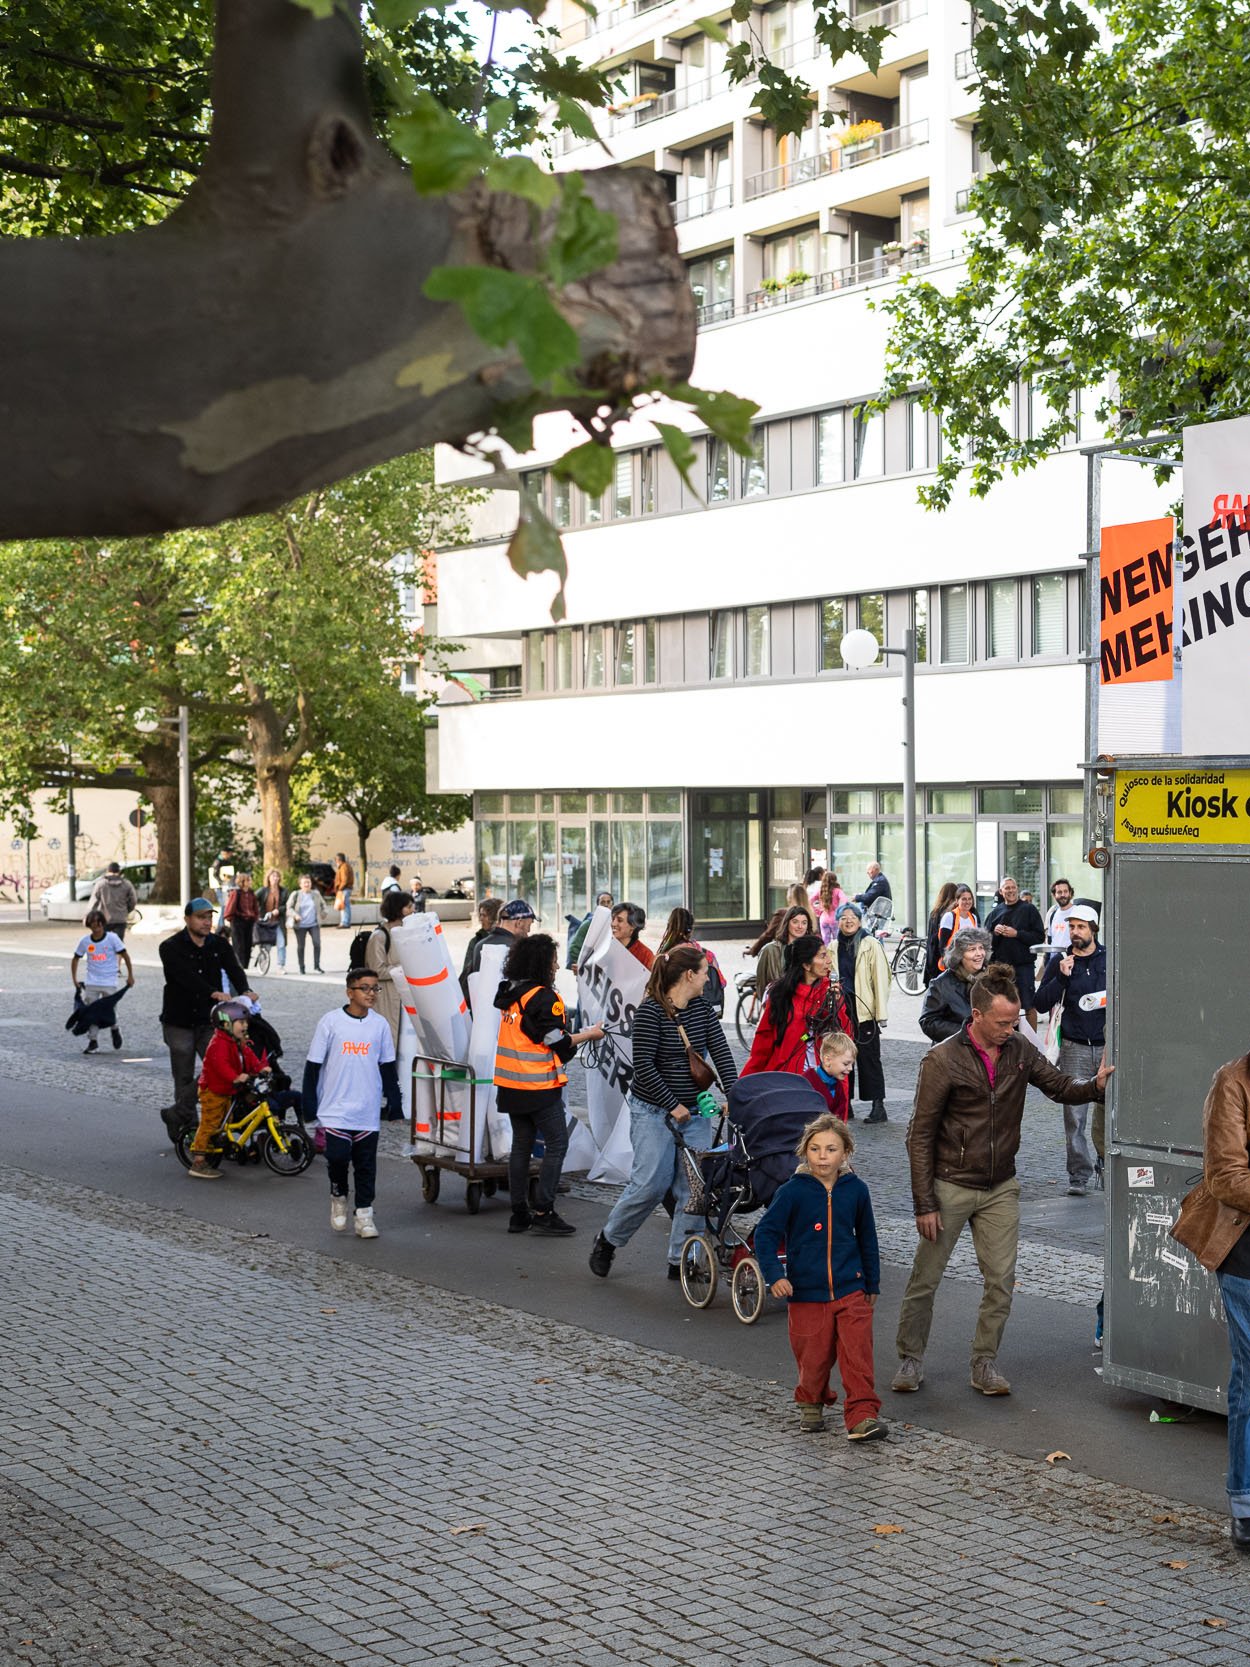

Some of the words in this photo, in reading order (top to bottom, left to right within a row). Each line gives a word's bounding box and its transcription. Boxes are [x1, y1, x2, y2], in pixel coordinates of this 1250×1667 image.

[1119, 777, 1149, 808] Quiosco
[1151, 776, 1163, 786] de
[1164, 776, 1173, 786] la
[1174, 773, 1225, 786] solidaridad
[1167, 787, 1238, 819] Kiosk
[1121, 818, 1149, 838] büfesi
[772, 839, 780, 855] 4
